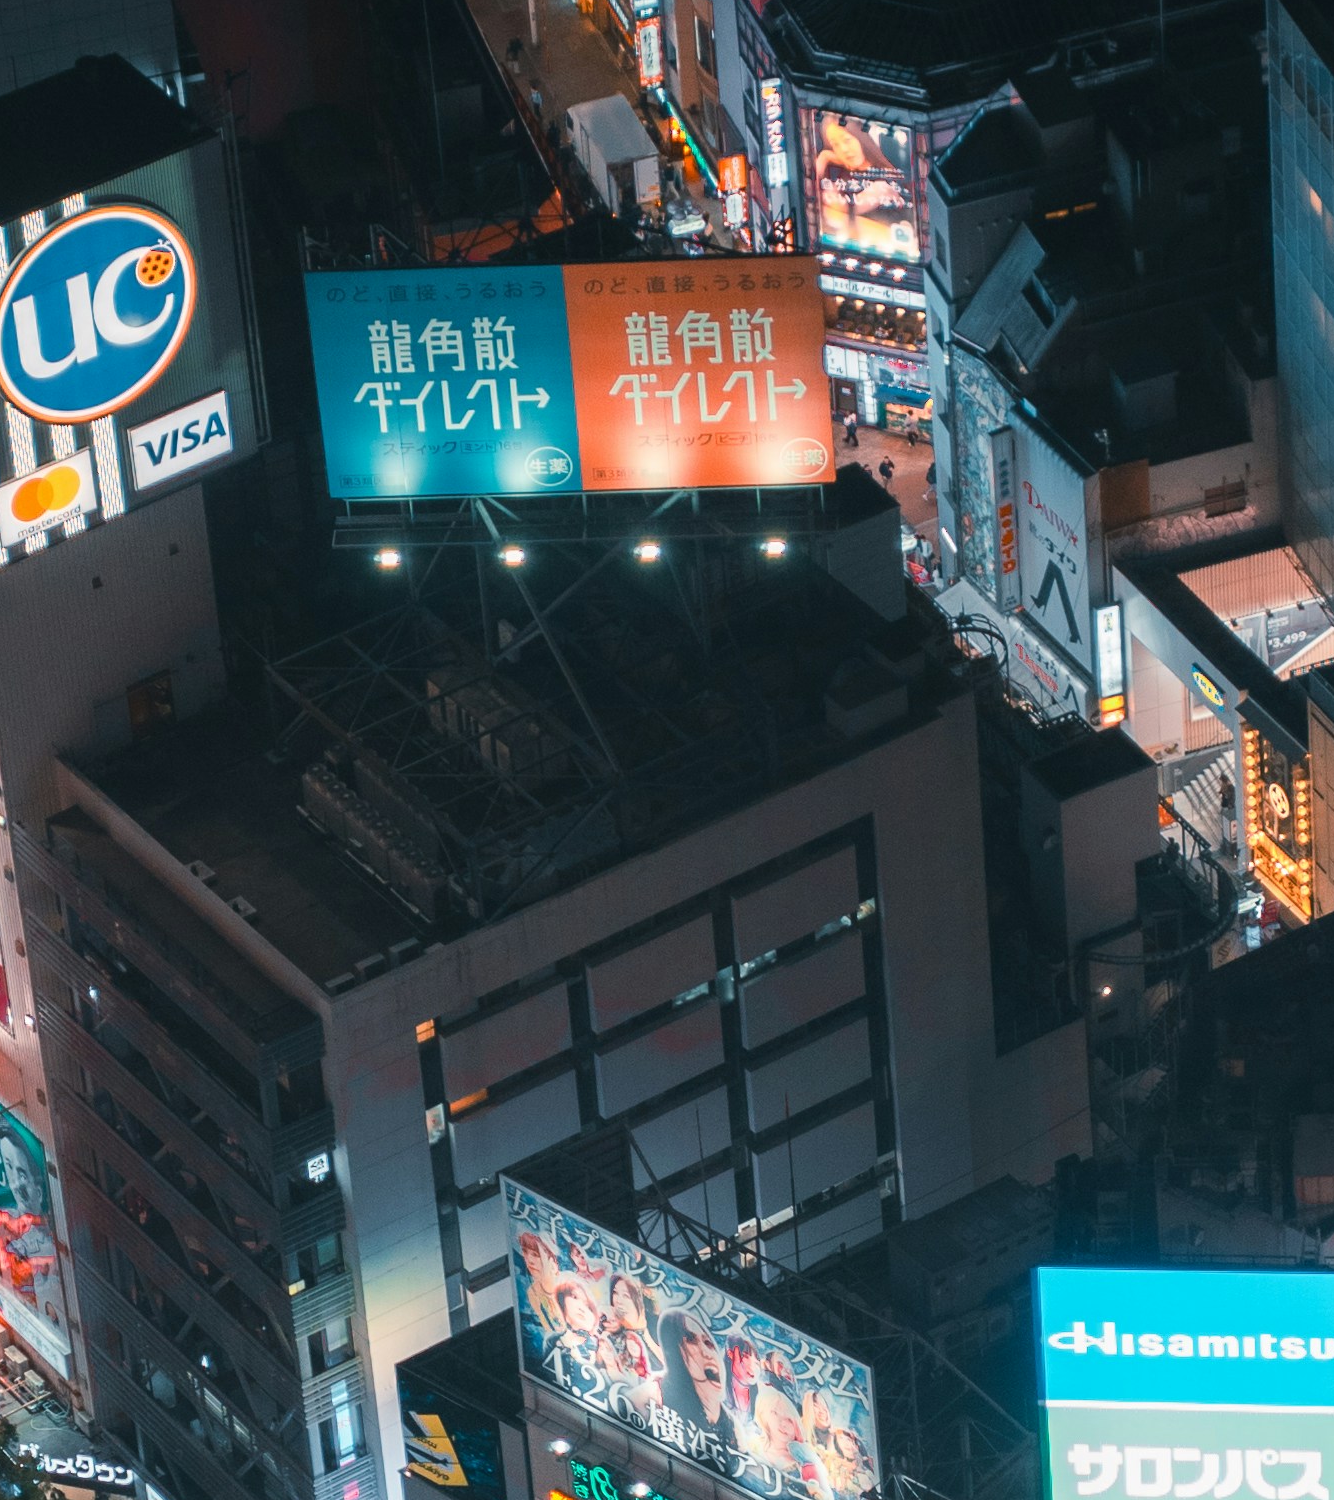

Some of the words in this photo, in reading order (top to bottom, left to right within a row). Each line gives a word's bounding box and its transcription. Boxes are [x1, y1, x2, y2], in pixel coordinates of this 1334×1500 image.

[326, 281, 548, 304] のど、直接、うるおう
[583, 271, 807, 297] のど、直接、うるおう
[368, 315, 519, 375] 龍角散
[624, 307, 776, 367] 龍角散
[353, 377, 551, 434] ダイレクト
[609, 368, 808, 426] ダイレクト
[134, 411, 229, 466] VISA
[382, 440, 457, 456] スティック
[528, 456, 570, 476] 生薬
[638, 432, 713, 448] スティック
[783, 448, 826, 468] 生薬
[17, 503, 84, 540] mastercard
[667, 1279, 871, 1406] スターダム
[542, 1346, 634, 1418] 4.26
[1068, 1443, 1330, 1500] サロンパス
